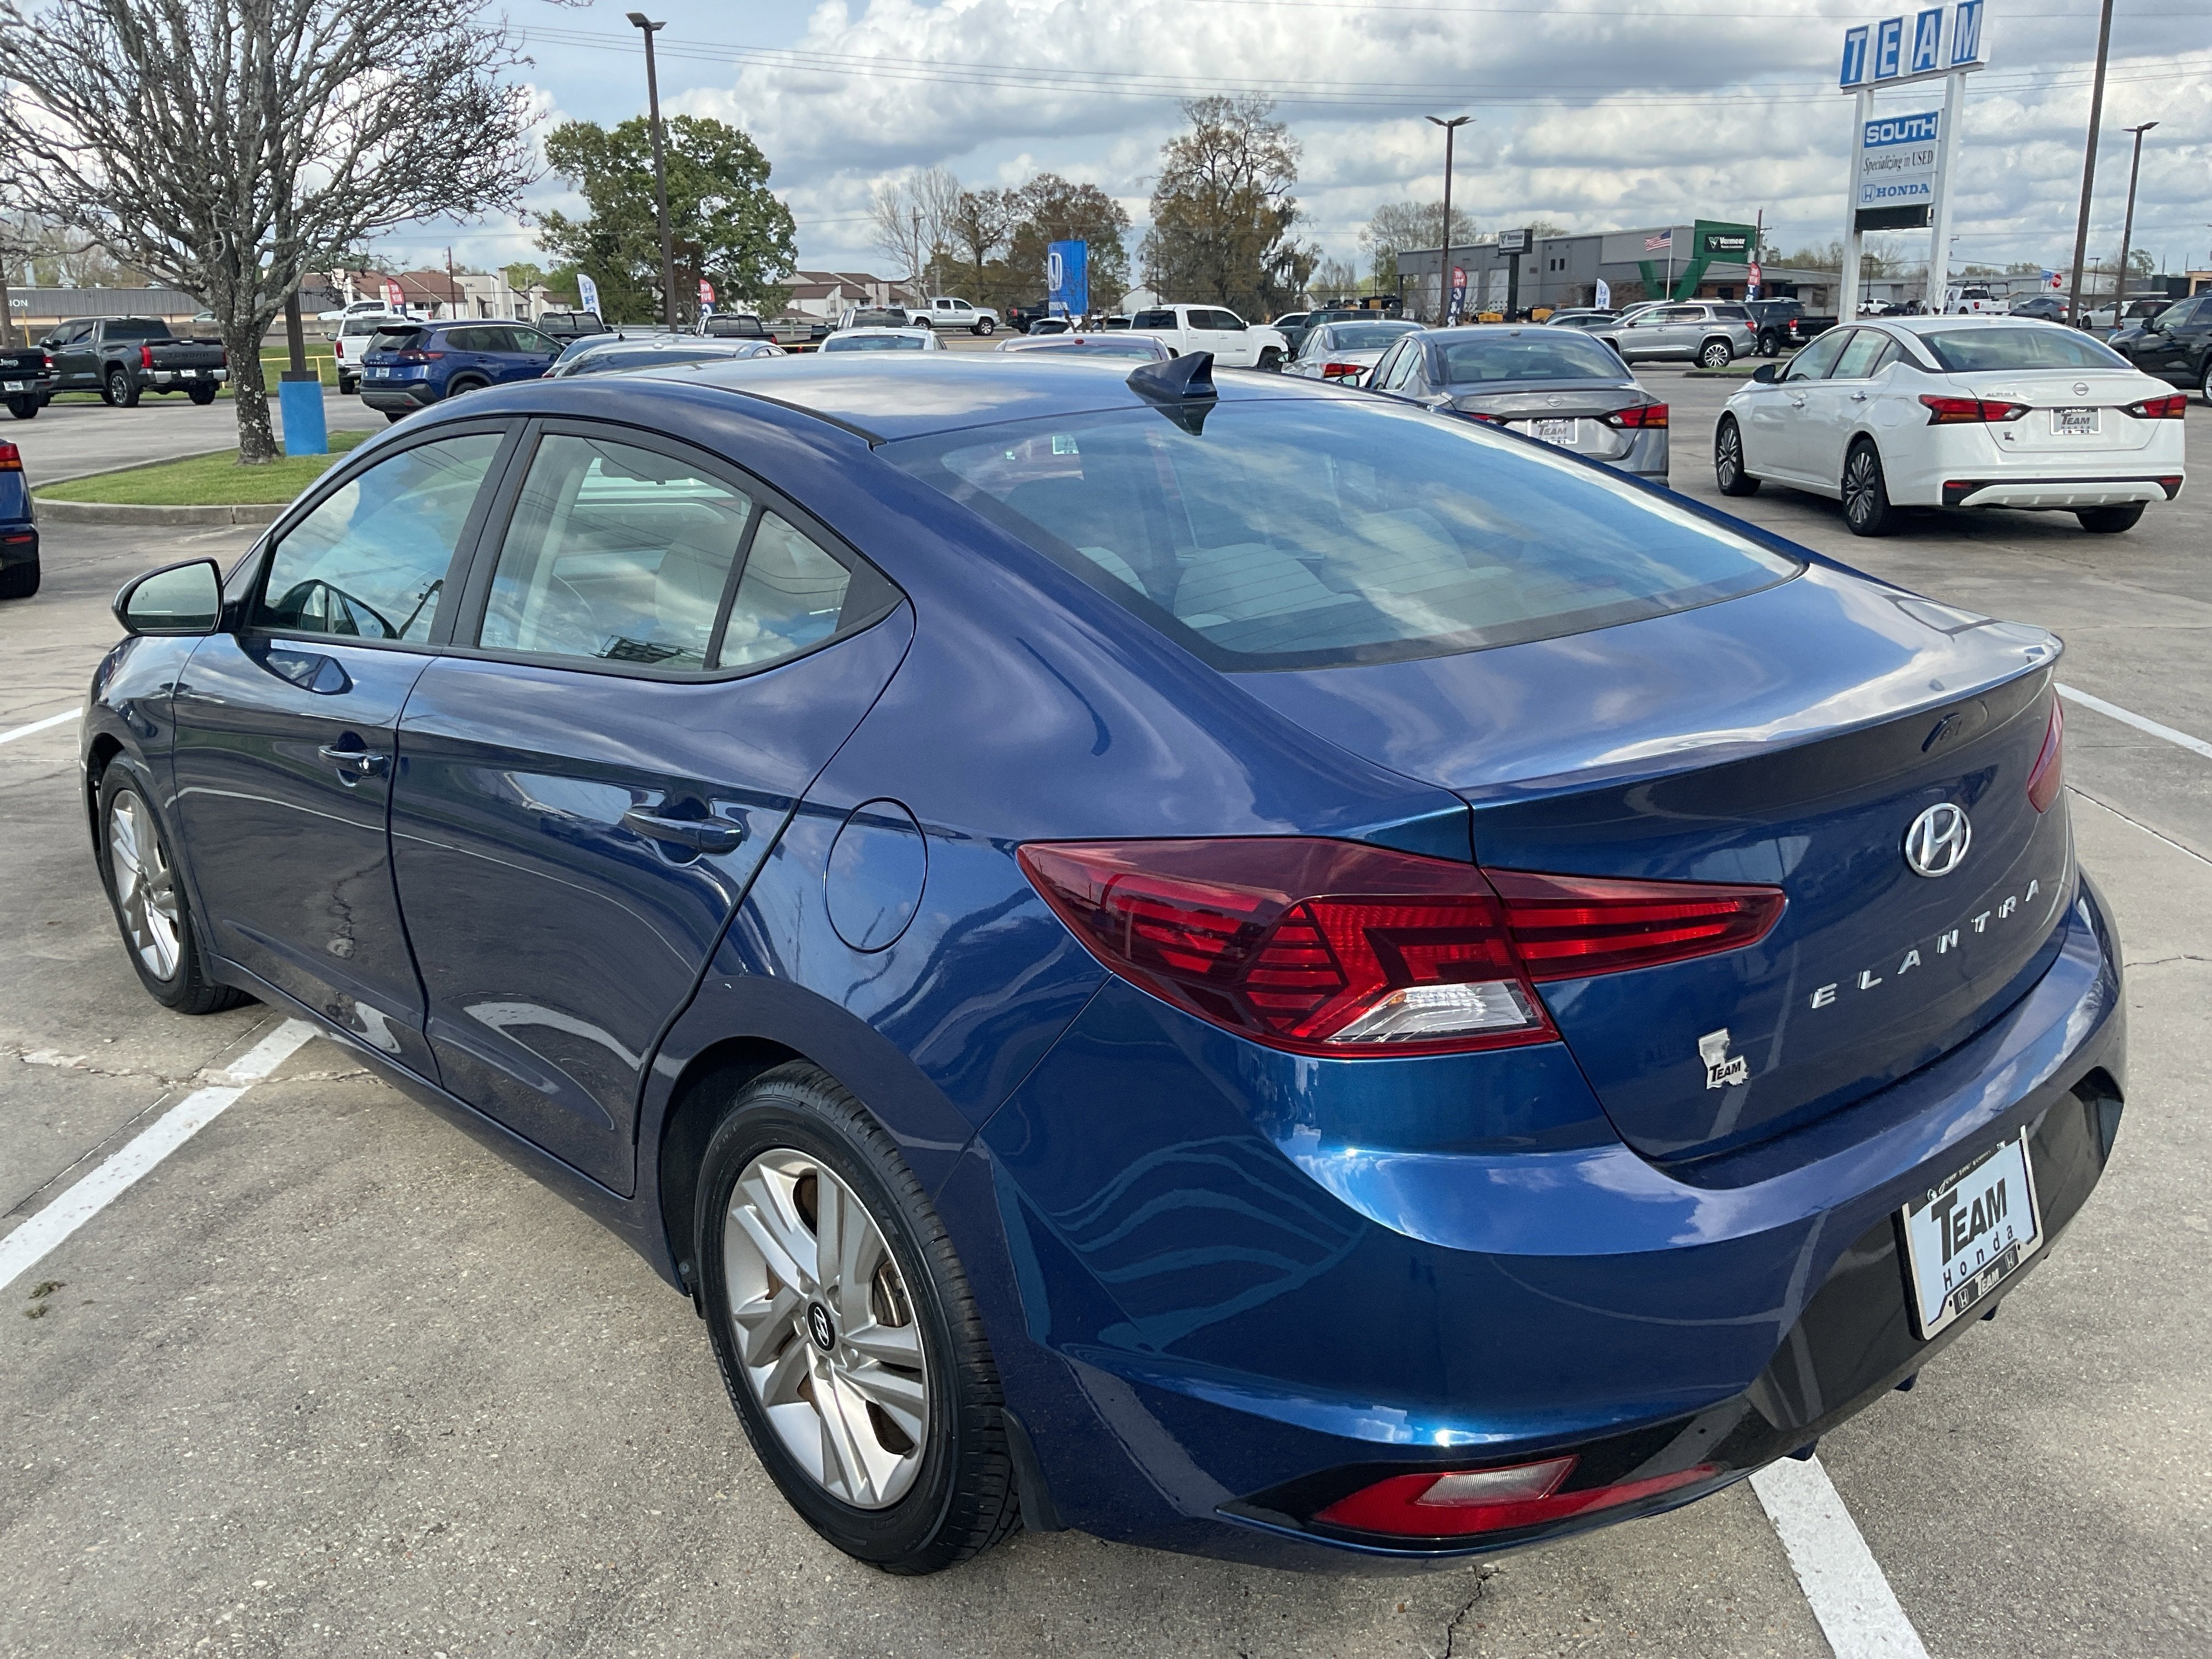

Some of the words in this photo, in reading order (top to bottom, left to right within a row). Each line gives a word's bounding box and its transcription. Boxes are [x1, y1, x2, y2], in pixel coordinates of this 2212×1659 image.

[1848, 3, 1983, 81] TEAM
[1866, 117, 1936, 143] SOUTH
[1864, 155, 1903, 175] Specializing
[1904, 153, 1910, 167] in
[1912, 150, 1933, 166] USED
[1876, 184, 1929, 198] HONDA
[1537, 424, 1567, 436] TEAM
[2061, 414, 2090, 425] TEAM
[1811, 879, 2039, 1009] ELANTRA
[1709, 1060, 1741, 1082] TEAM
[1931, 1177, 2007, 1266] TEAM
[1943, 1224, 2013, 1291] Honda
[1974, 1268, 2000, 1296] TEAM
